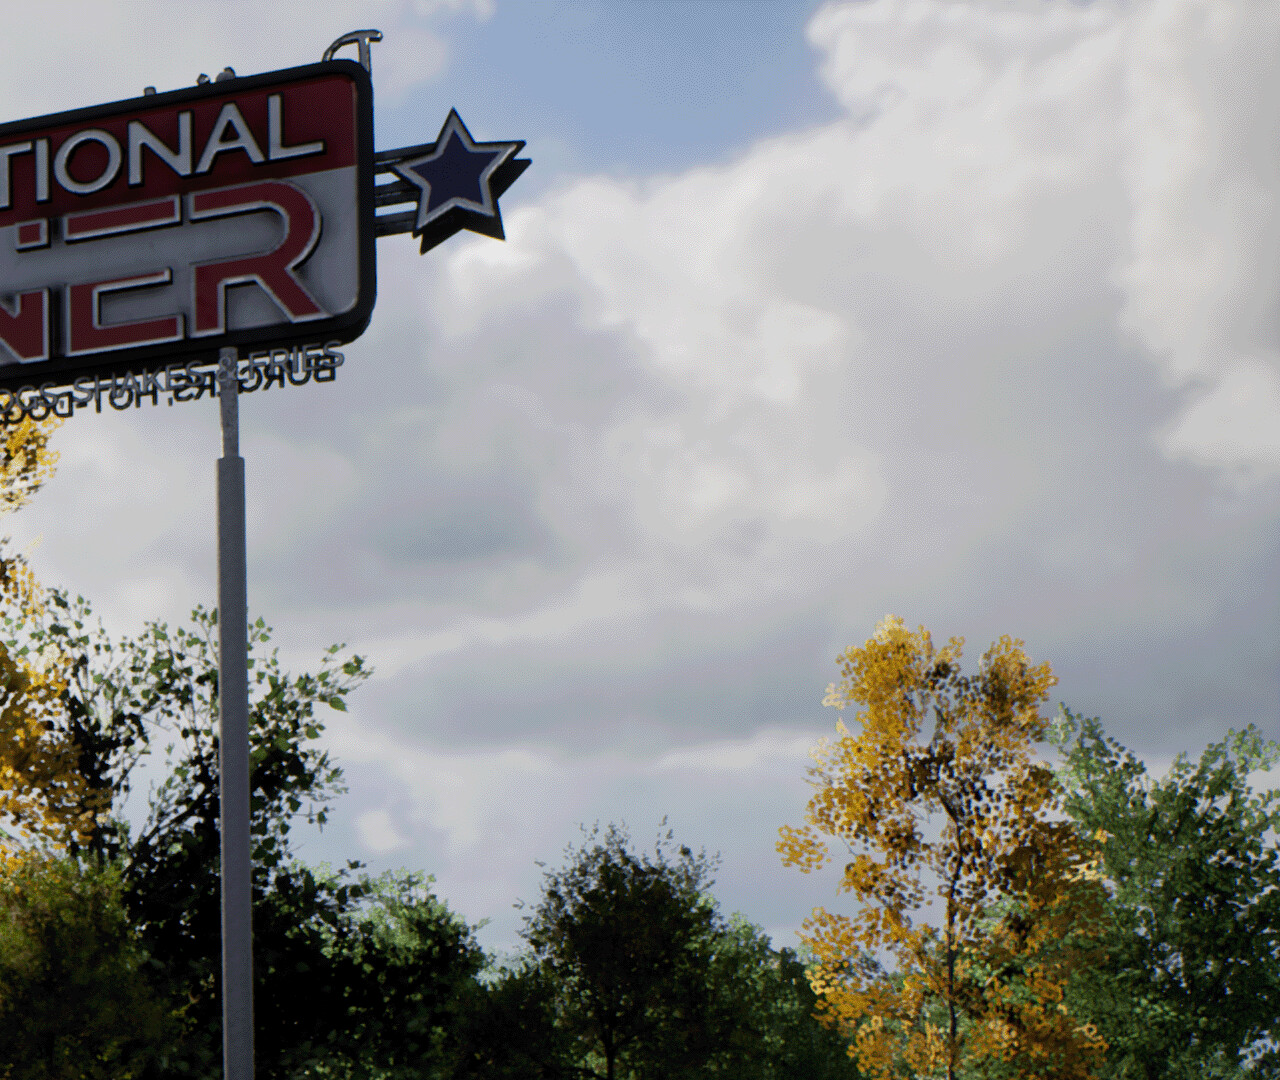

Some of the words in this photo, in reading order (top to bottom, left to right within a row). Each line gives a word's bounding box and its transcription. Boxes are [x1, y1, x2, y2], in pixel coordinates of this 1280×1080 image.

[73, 359, 206, 404] SHAKES
[215, 353, 238, 384] &
[249, 340, 346, 380] FRIES
